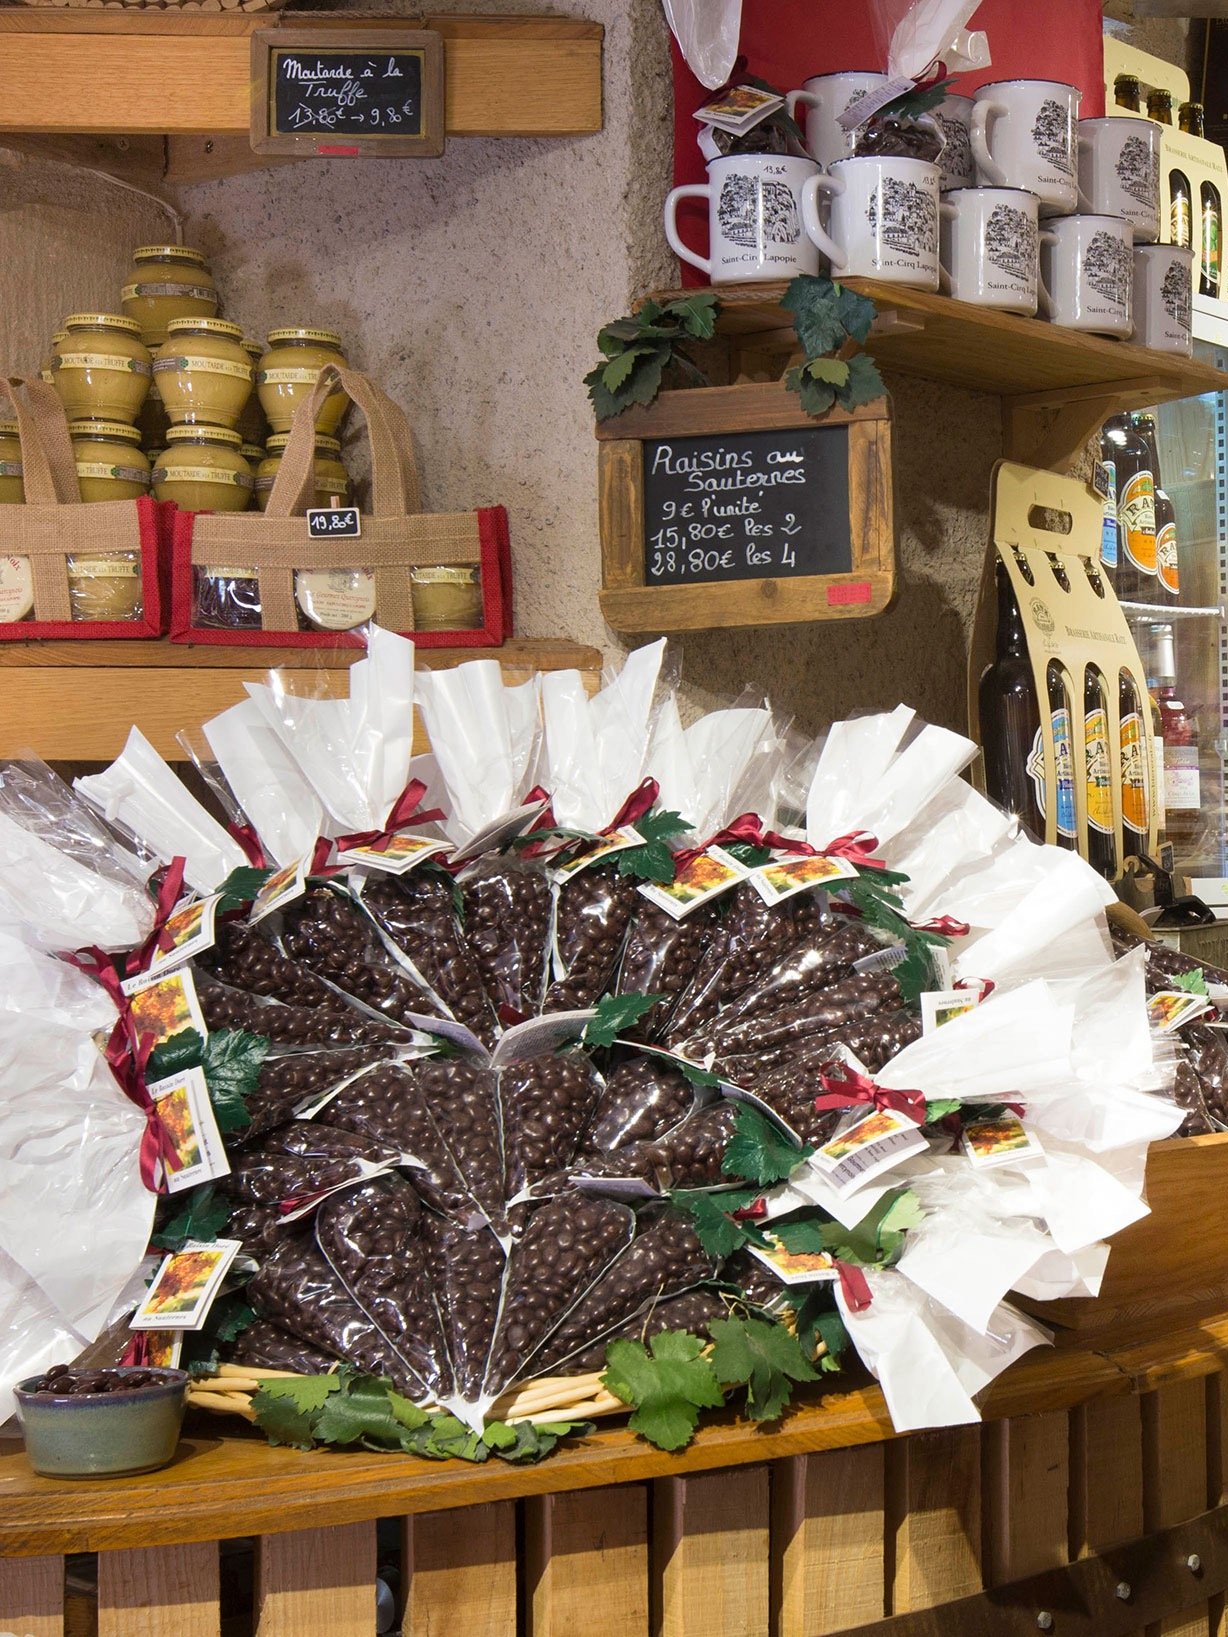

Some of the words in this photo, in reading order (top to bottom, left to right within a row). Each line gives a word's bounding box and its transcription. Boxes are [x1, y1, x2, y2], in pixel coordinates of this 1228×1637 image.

[283, 58, 354, 79] Moutarde
[360, 61, 377, 78] à
[382, 57, 403, 78] la
[298, 80, 368, 106] Truffe
[370, 99, 414, 127] 9,80€
[721, 253, 760, 265] Saint-Cir
[763, 253, 798, 265] Lapopie
[871, 259, 916, 270] Sint-Cirq
[652, 445, 753, 475] Raisins
[766, 450, 804, 465] au
[169, 470, 203, 481] MOUTARDE
[683, 468, 807, 492] Sauternes
[702, 490, 764, 519] l'unité
[311, 512, 355, 531] 19,80€
[651, 523, 735, 550] 15,80€
[744, 518, 774, 536] les
[780, 513, 803, 535] 2
[650, 549, 736, 577] 28,80€
[746, 542, 773, 565] les
[780, 542, 796, 568] 4
